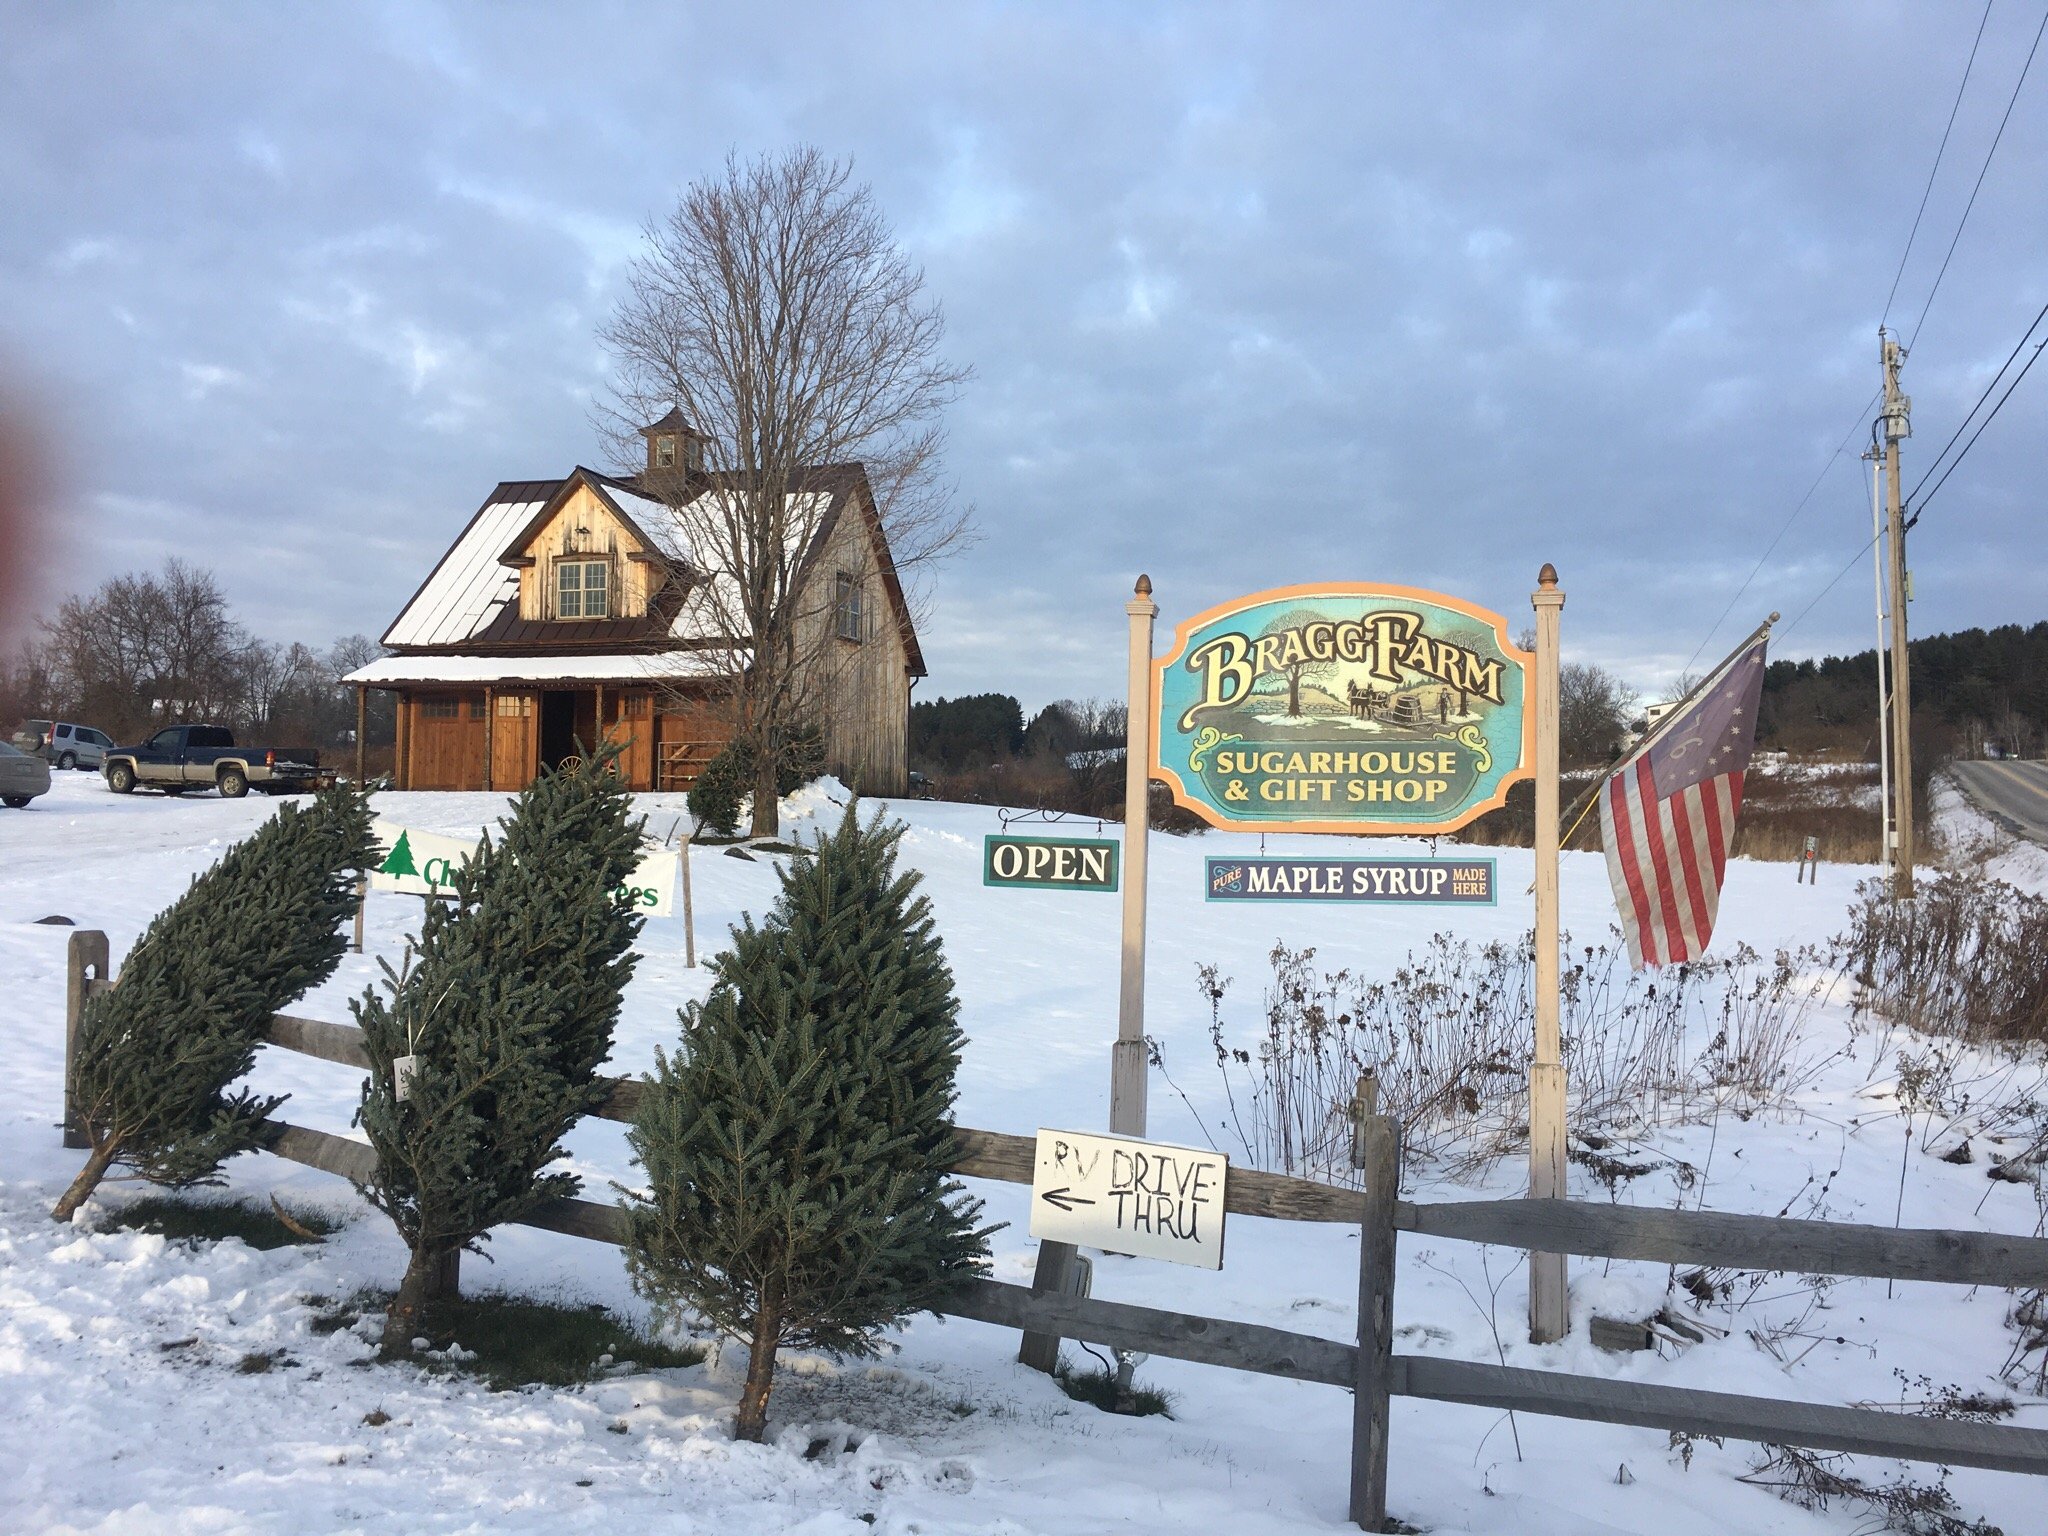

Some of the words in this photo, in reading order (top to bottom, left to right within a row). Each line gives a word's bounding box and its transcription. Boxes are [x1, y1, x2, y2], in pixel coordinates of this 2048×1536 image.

[1178, 619, 1366, 733] BRAGG
[1365, 610, 1505, 706] FARM
[1216, 751, 1457, 775] SUGARHOUSE
[1224, 780, 1249, 801] &
[1259, 779, 1337, 801] GIFT
[1347, 778, 1449, 803] SHOP
[992, 844, 1110, 882] OPEN
[1453, 868, 1487, 882] MADE
[1212, 866, 1242, 892] PURE
[1246, 866, 1345, 894] MAPLE
[1352, 867, 1447, 896] SYRUP
[1453, 882, 1487, 896] HERE
[1053, 1140, 1101, 1184] RV
[1112, 1149, 1216, 1203] DRIVE
[1108, 1190, 1203, 1244] THRU
